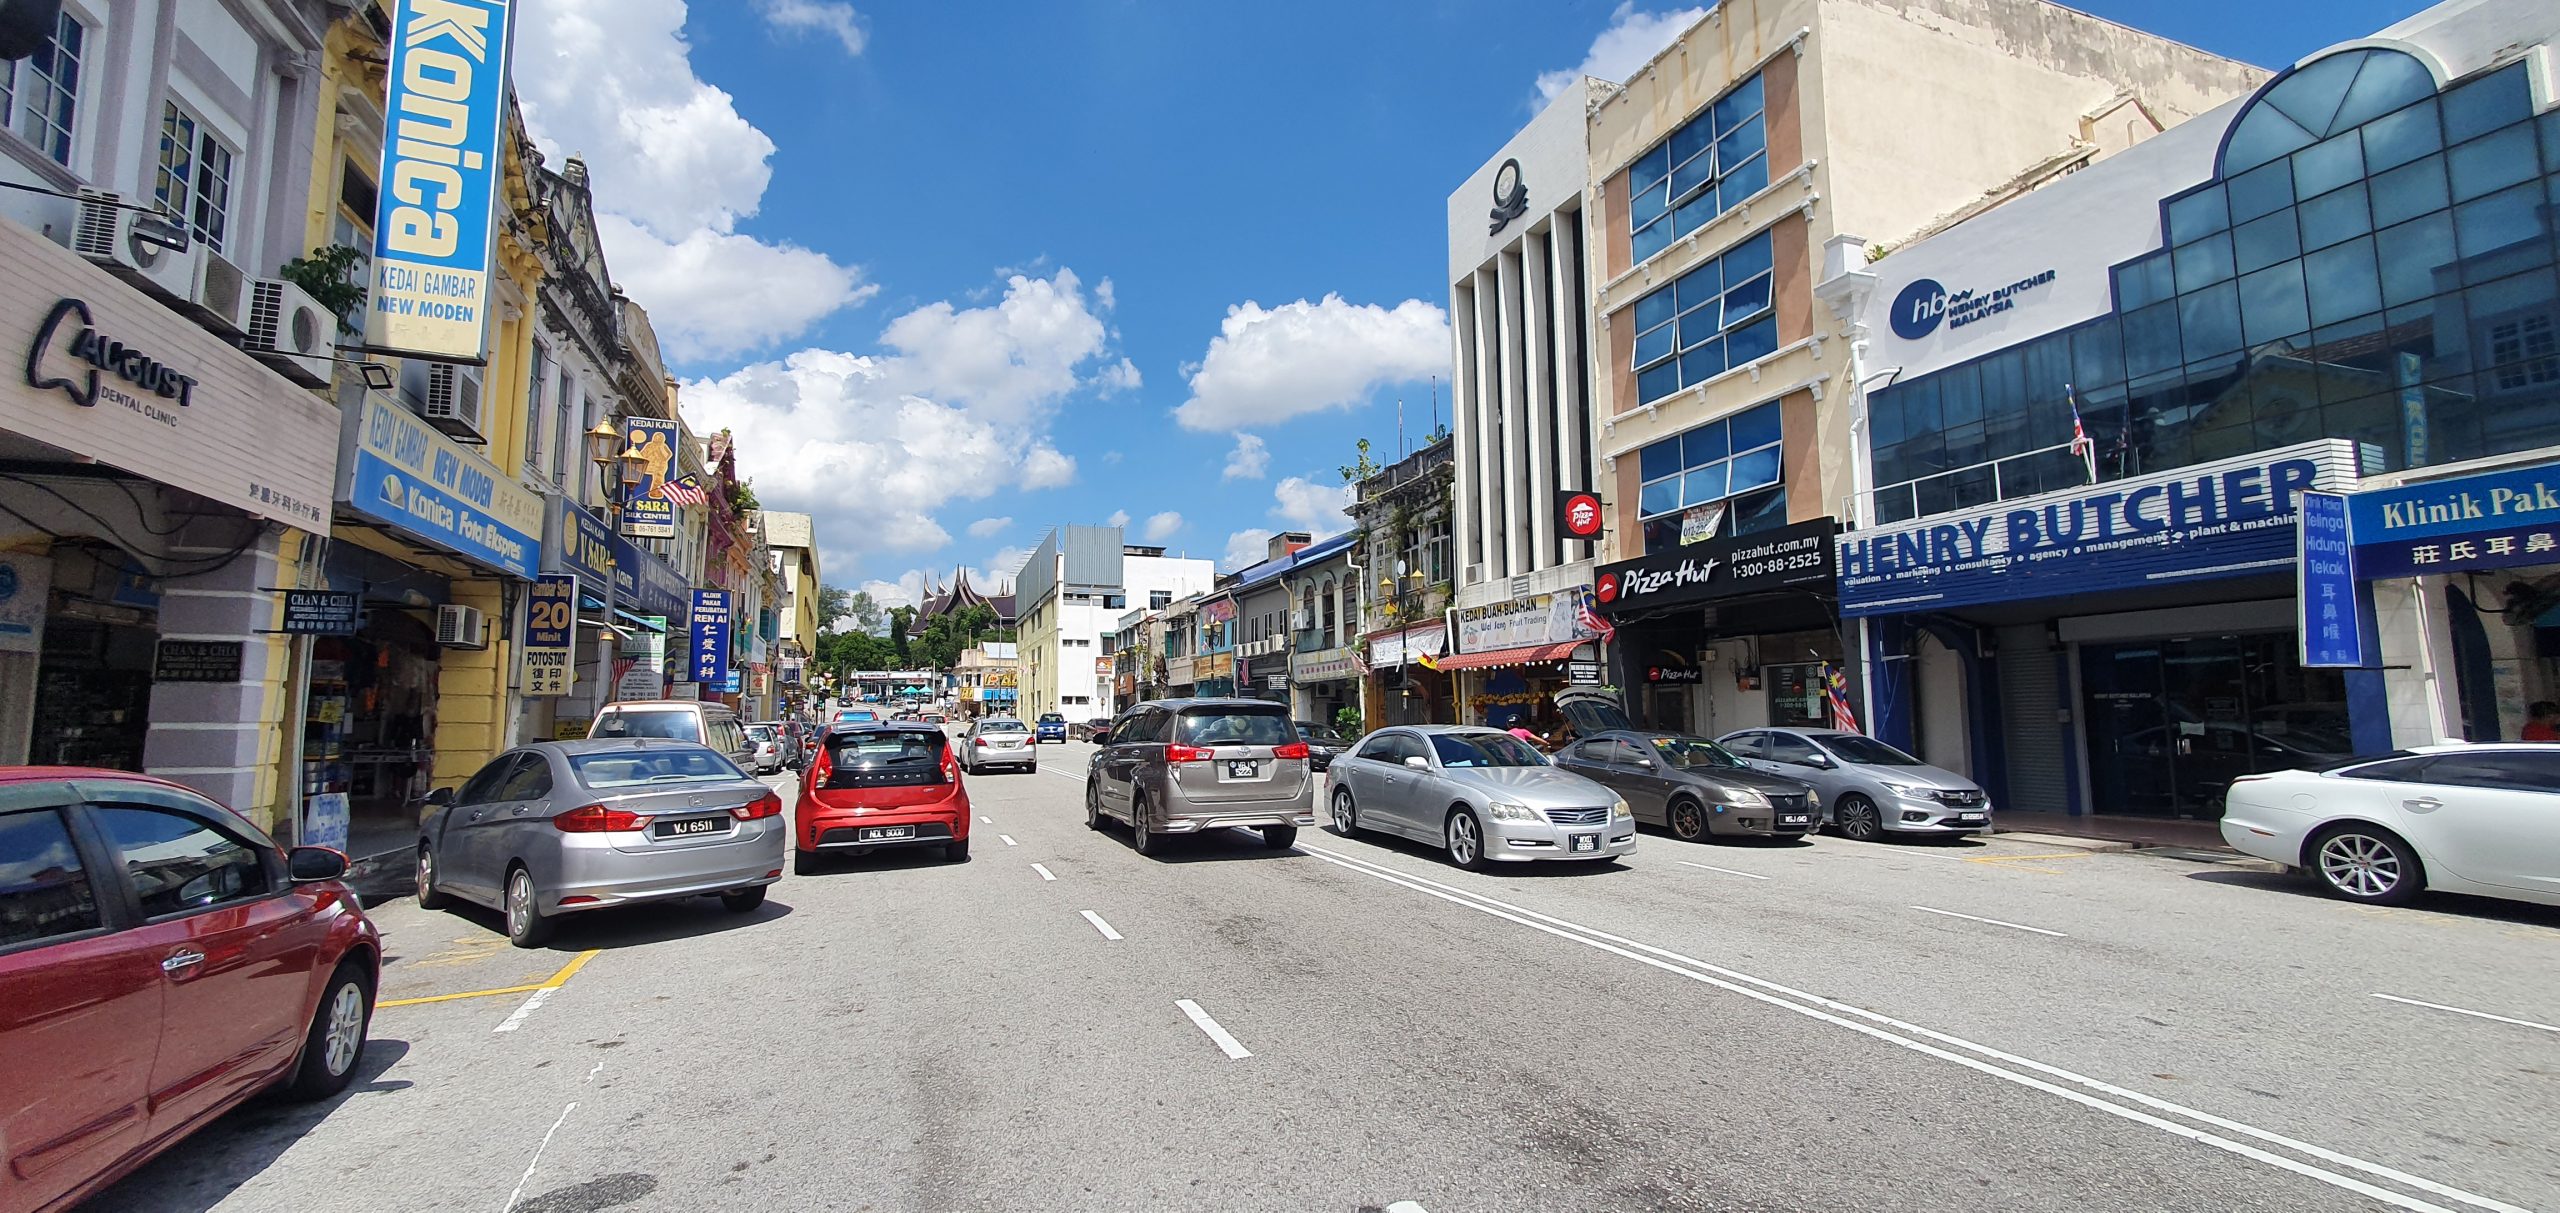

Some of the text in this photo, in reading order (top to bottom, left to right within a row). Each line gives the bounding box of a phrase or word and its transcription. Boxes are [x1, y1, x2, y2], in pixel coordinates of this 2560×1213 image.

[386, 0, 490, 258] Konica
[379, 265, 476, 300] KEDAI GAMBAR
[1948, 269, 2056, 318] HENRY BUTCHER
[377, 295, 474, 323] NEW MODEN
[1911, 291, 1947, 324] hb
[1949, 298, 2014, 330] MALAYSIA
[70, 328, 199, 407] AUGUST
[101, 386, 178, 427] DENTAL CLINIC
[630, 419, 675, 430] KEDAI KAIN
[369, 403, 494, 510] KEDAI GAMBAR NEW MODEN
[636, 500, 670, 512] SARA
[1841, 458, 2318, 577] HENRY BUTCHER
[2382, 482, 2560, 529] Klinik Pak
[408, 486, 454, 532] Konica
[458, 510, 483, 543] Foto
[485, 524, 522, 561] Ekspres
[2305, 512, 2344, 532] Telinga
[1731, 534, 1820, 564] pizzahut.com.my
[1844, 574, 1882, 586] valuation
[1954, 556, 2013, 572] consultancy
[2030, 545, 2069, 562] agency
[2086, 532, 2169, 553] management
[2189, 522, 2227, 540] plant
[2229, 522, 2241, 532] &
[2305, 536, 2346, 557] Hidung
[1621, 558, 1721, 598] Pizza Hut
[1732, 551, 1821, 580] 1-300-88-2525
[2310, 559, 2345, 576] Tekak
[290, 594, 354, 607] CHAN & CHIA
[557, 578, 571, 602] Siap
[702, 591, 722, 599] KLINIK
[531, 600, 570, 630] 20
[694, 615, 727, 623] REN AI
[1460, 597, 1537, 623] KEDAI BUAH-BUAHAN
[1524, 615, 1547, 625] Trading
[536, 631, 561, 642] Minit
[527, 651, 567, 666] FOTOSTAT
[1660, 668, 1699, 680] Pizza Hut
[673, 819, 713, 834] VJ 6511
